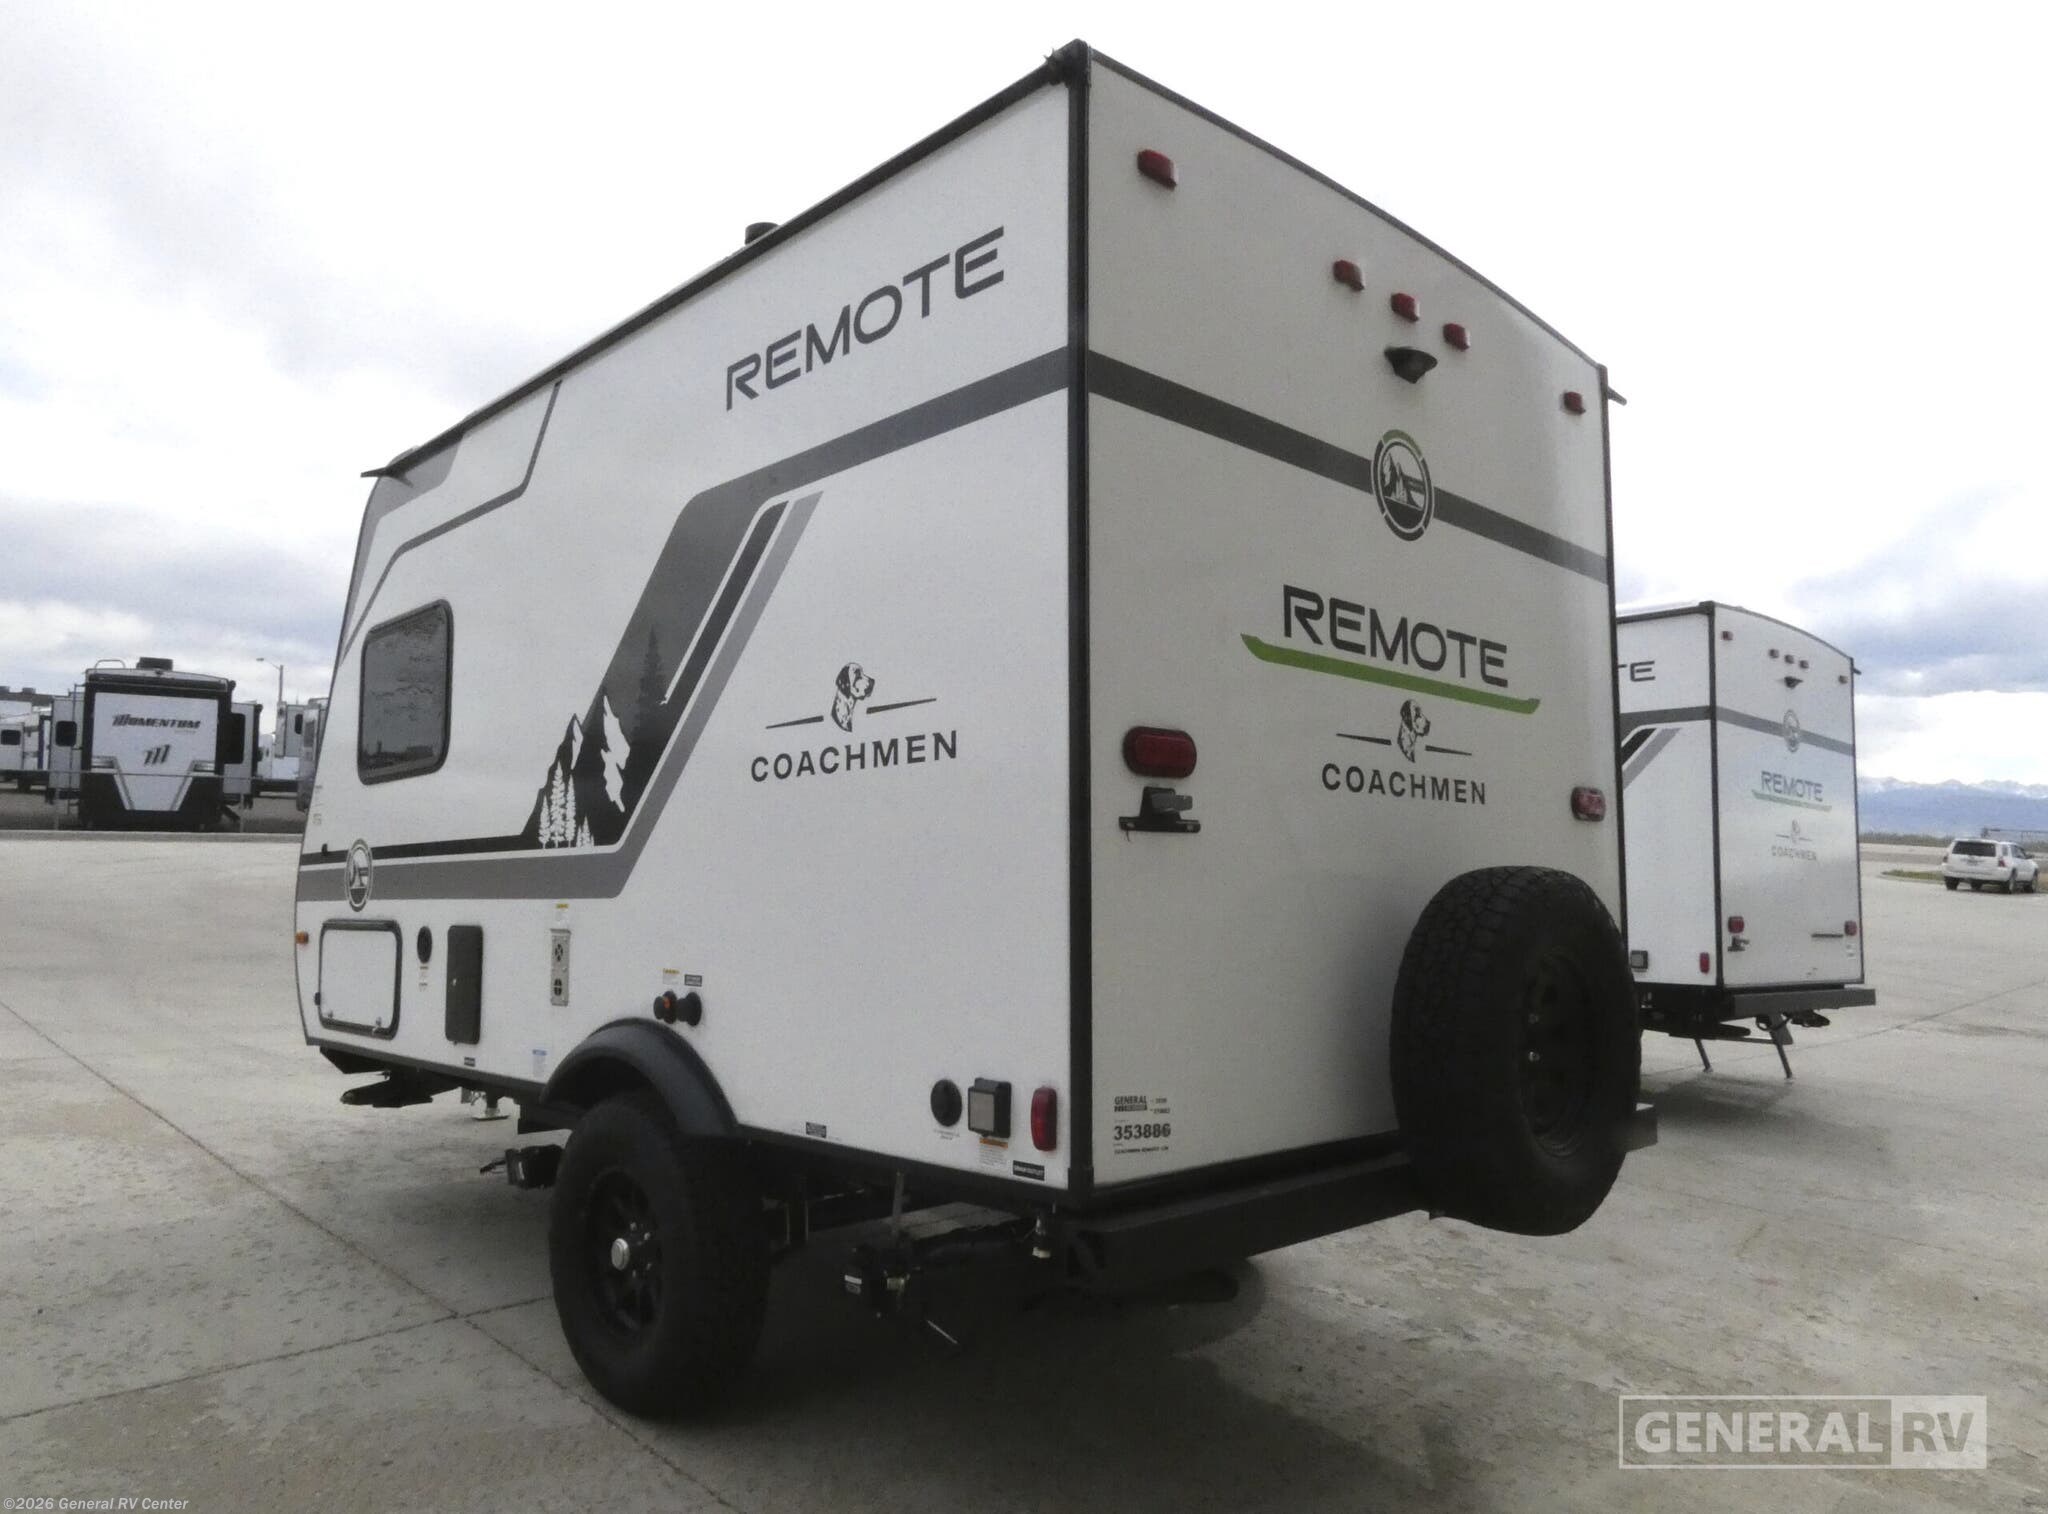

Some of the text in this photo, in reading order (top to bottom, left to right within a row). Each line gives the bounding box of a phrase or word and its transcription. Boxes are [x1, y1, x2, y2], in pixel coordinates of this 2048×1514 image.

[726, 225, 1005, 412] REMOTE
[1282, 584, 1508, 688] REMOTE
[751, 730, 957, 782] COACHMEN
[1321, 763, 1486, 805] COACHMEN
[1761, 770, 1824, 802] REMOTE
